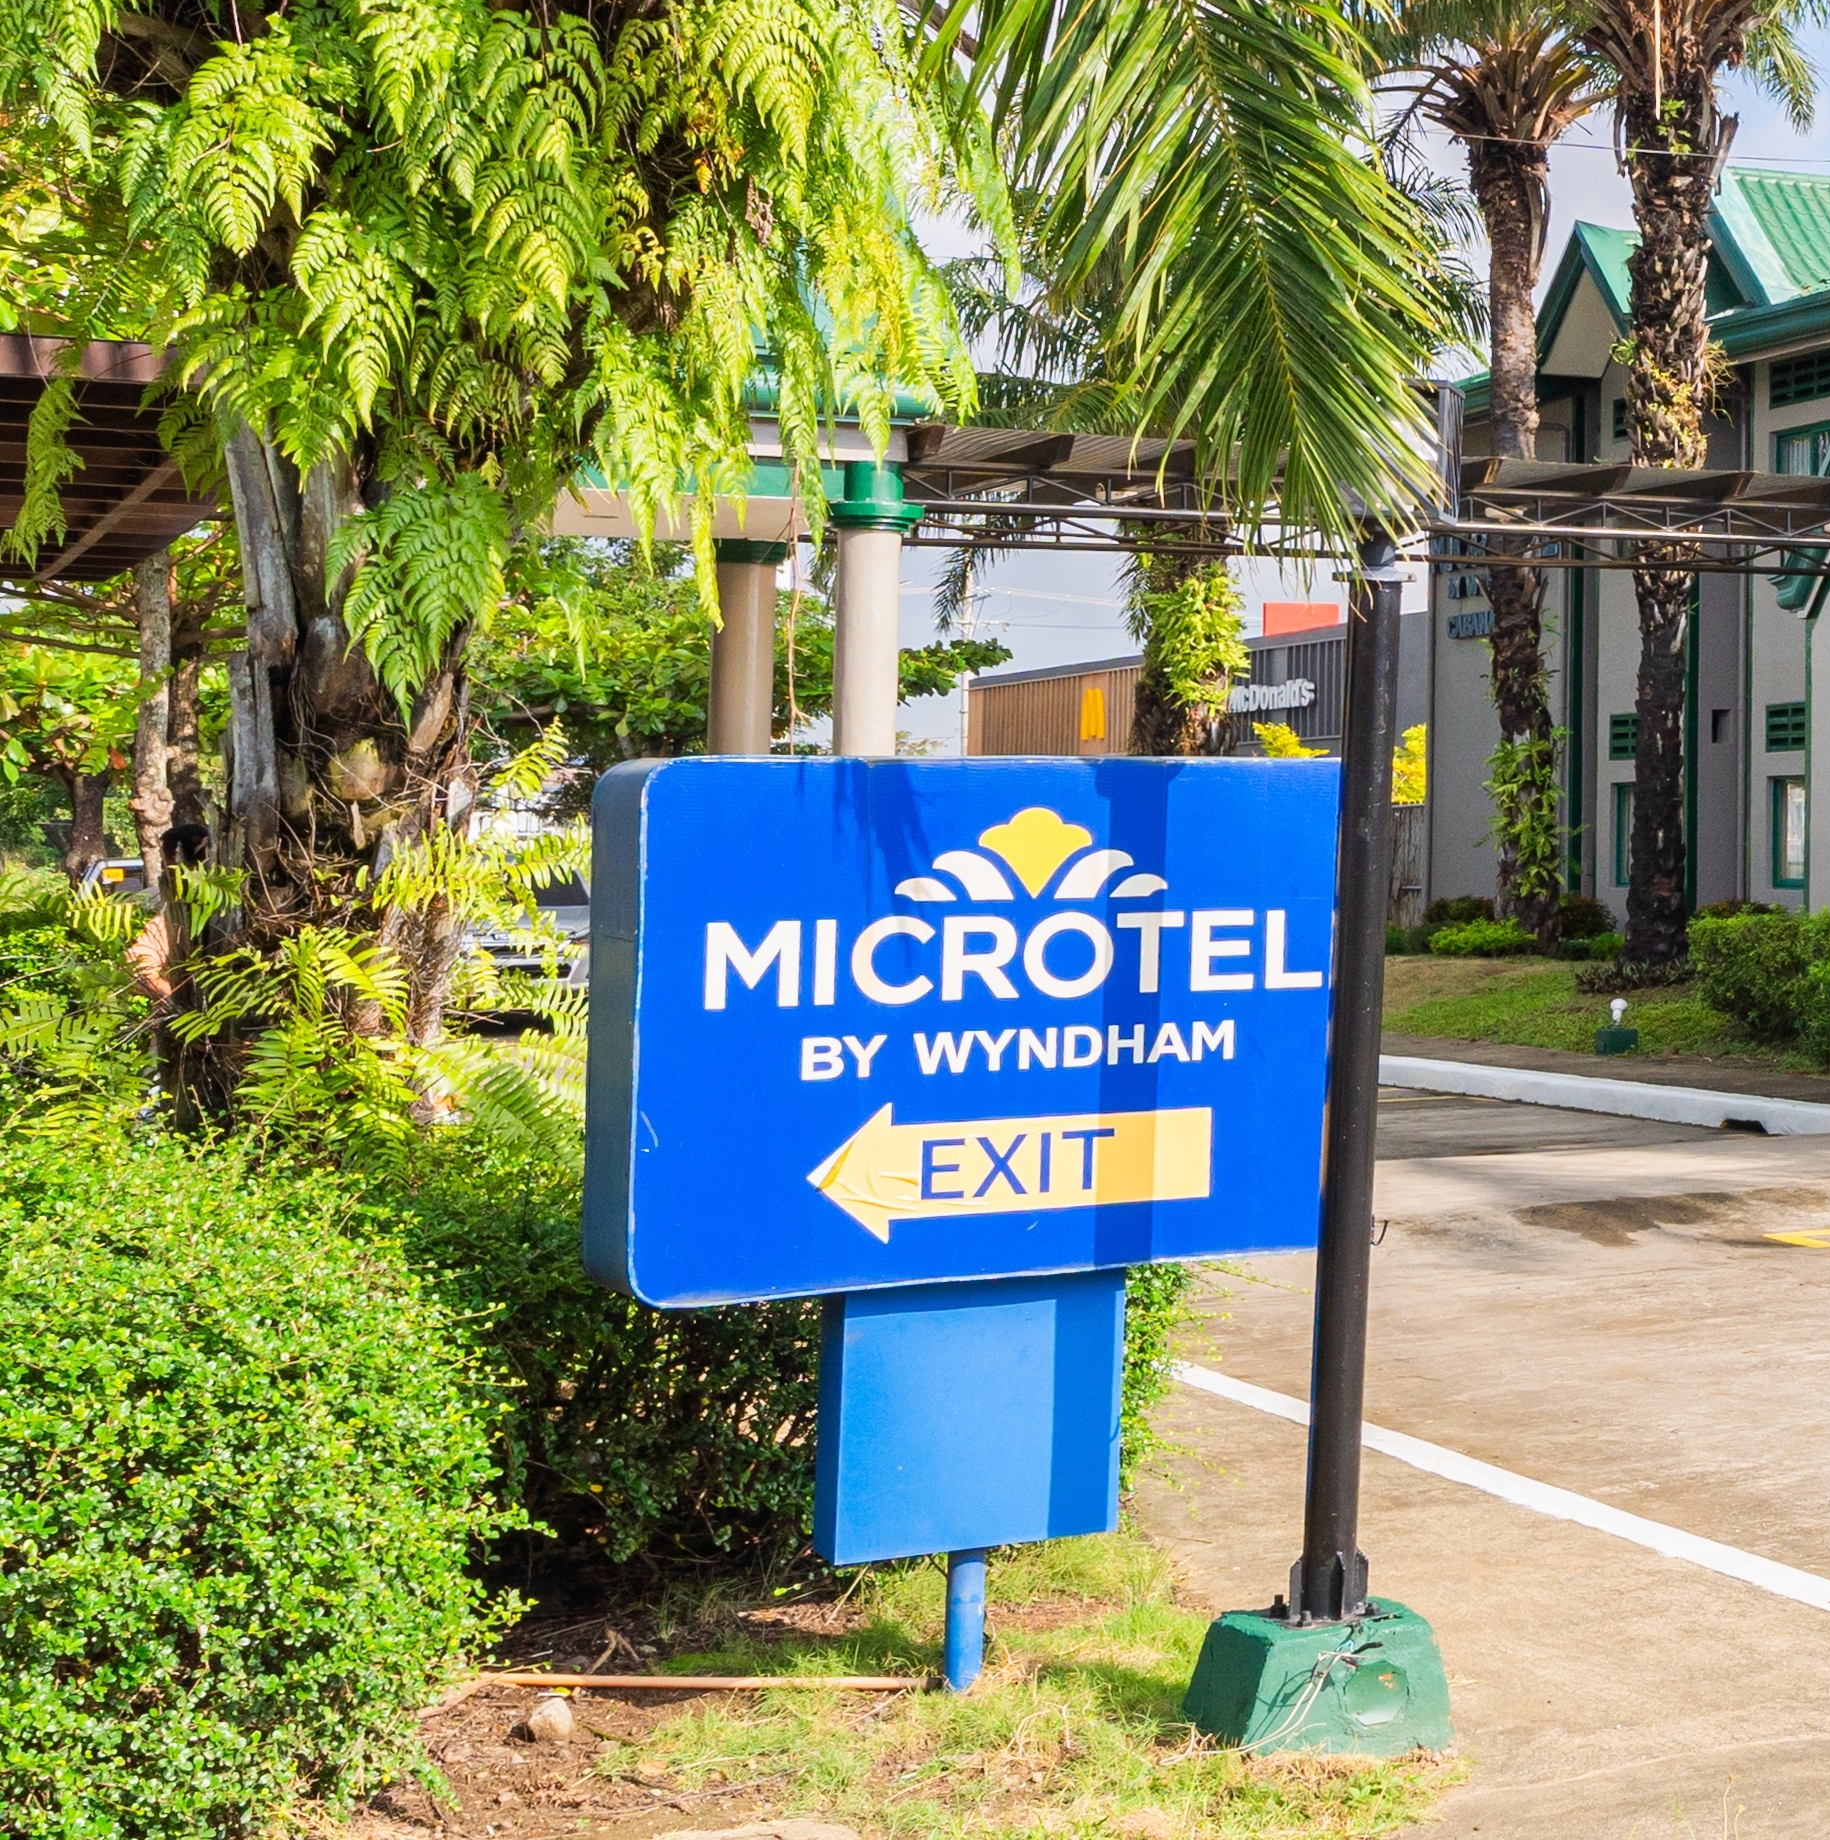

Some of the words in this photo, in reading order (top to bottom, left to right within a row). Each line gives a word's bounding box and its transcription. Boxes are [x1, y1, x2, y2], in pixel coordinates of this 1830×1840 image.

[1228, 678, 1316, 714] McDonald's
[704, 909, 1323, 1011] MICROTEL
[800, 1034, 887, 1081] BY
[913, 1020, 1235, 1075] WYNDHAM
[921, 1128, 1115, 1200] EXIT
